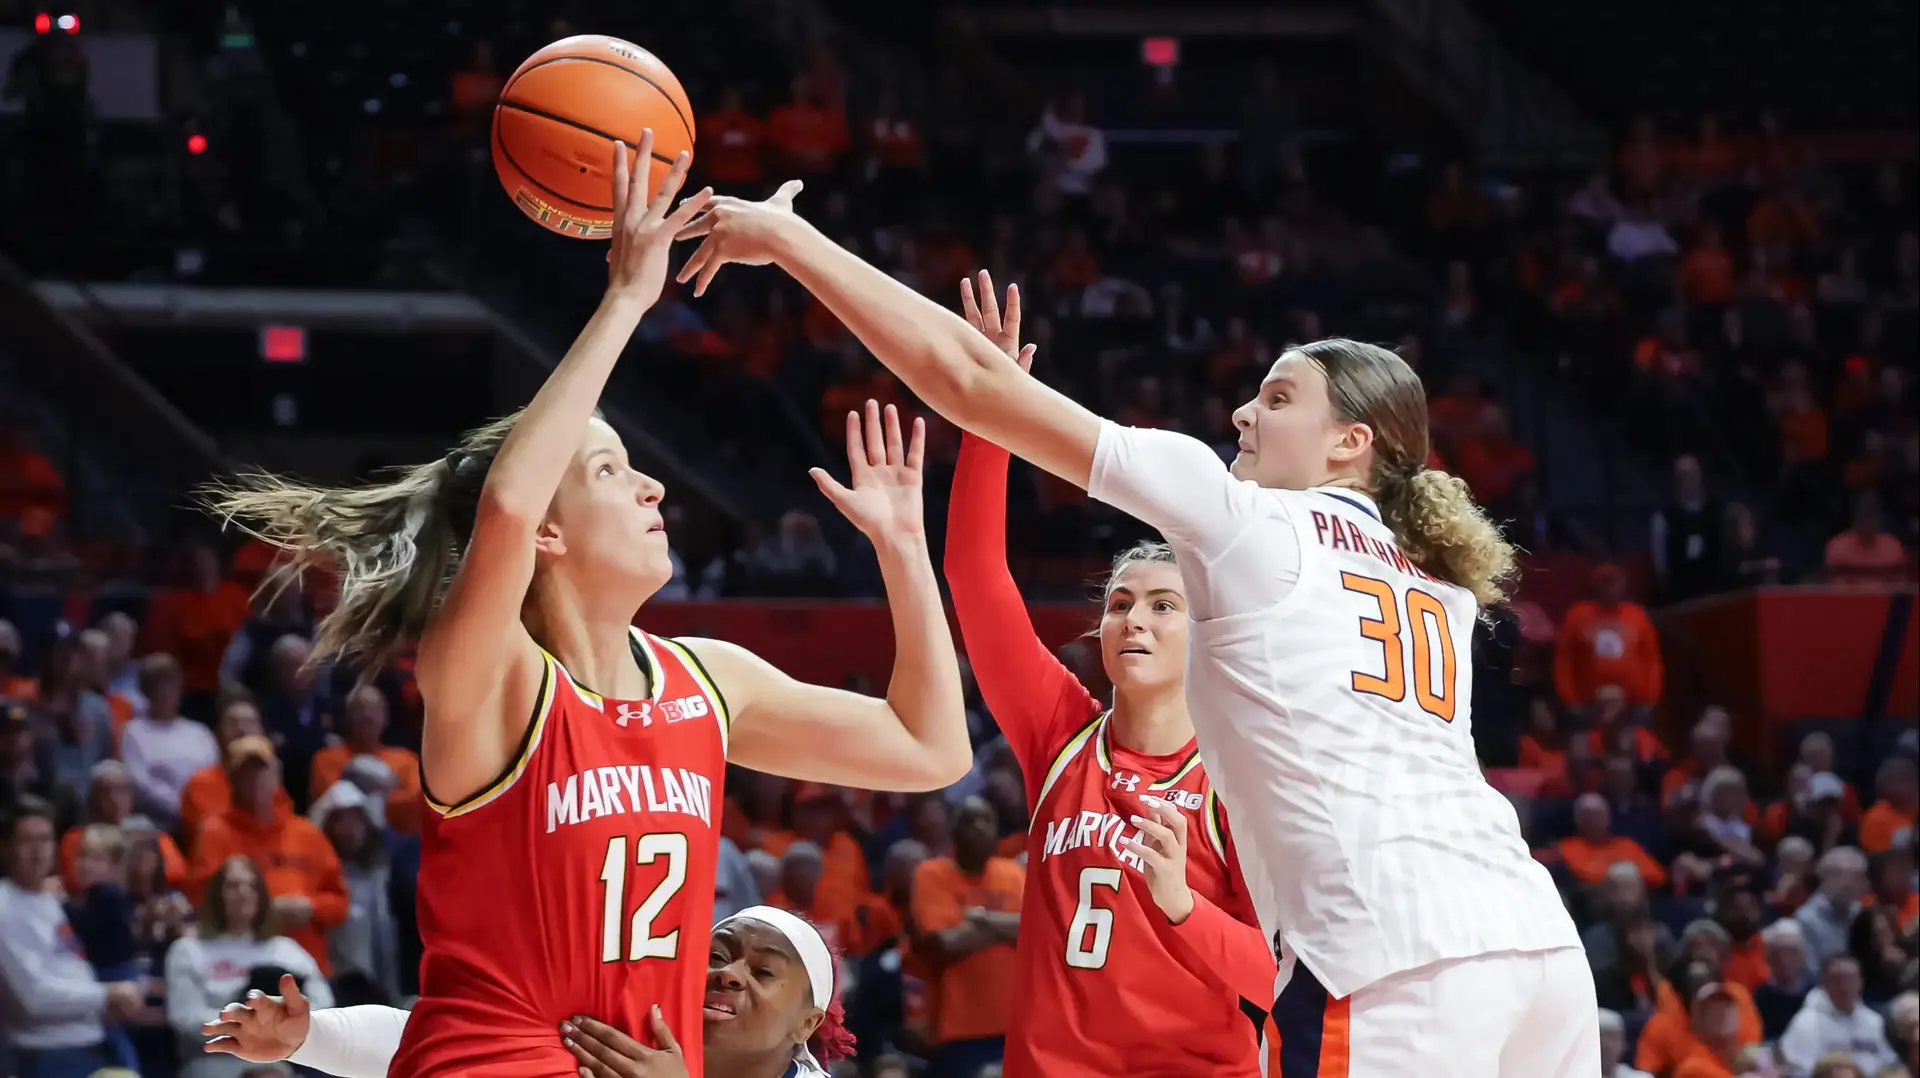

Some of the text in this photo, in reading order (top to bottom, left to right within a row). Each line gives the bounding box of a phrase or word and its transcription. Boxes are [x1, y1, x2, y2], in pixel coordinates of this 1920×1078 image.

[1339, 569, 1457, 725] 30
[546, 764, 712, 834] MARYLAND
[1041, 810, 1146, 875] MARYLA
[598, 831, 689, 965] 12
[1065, 865, 1124, 971] 6
